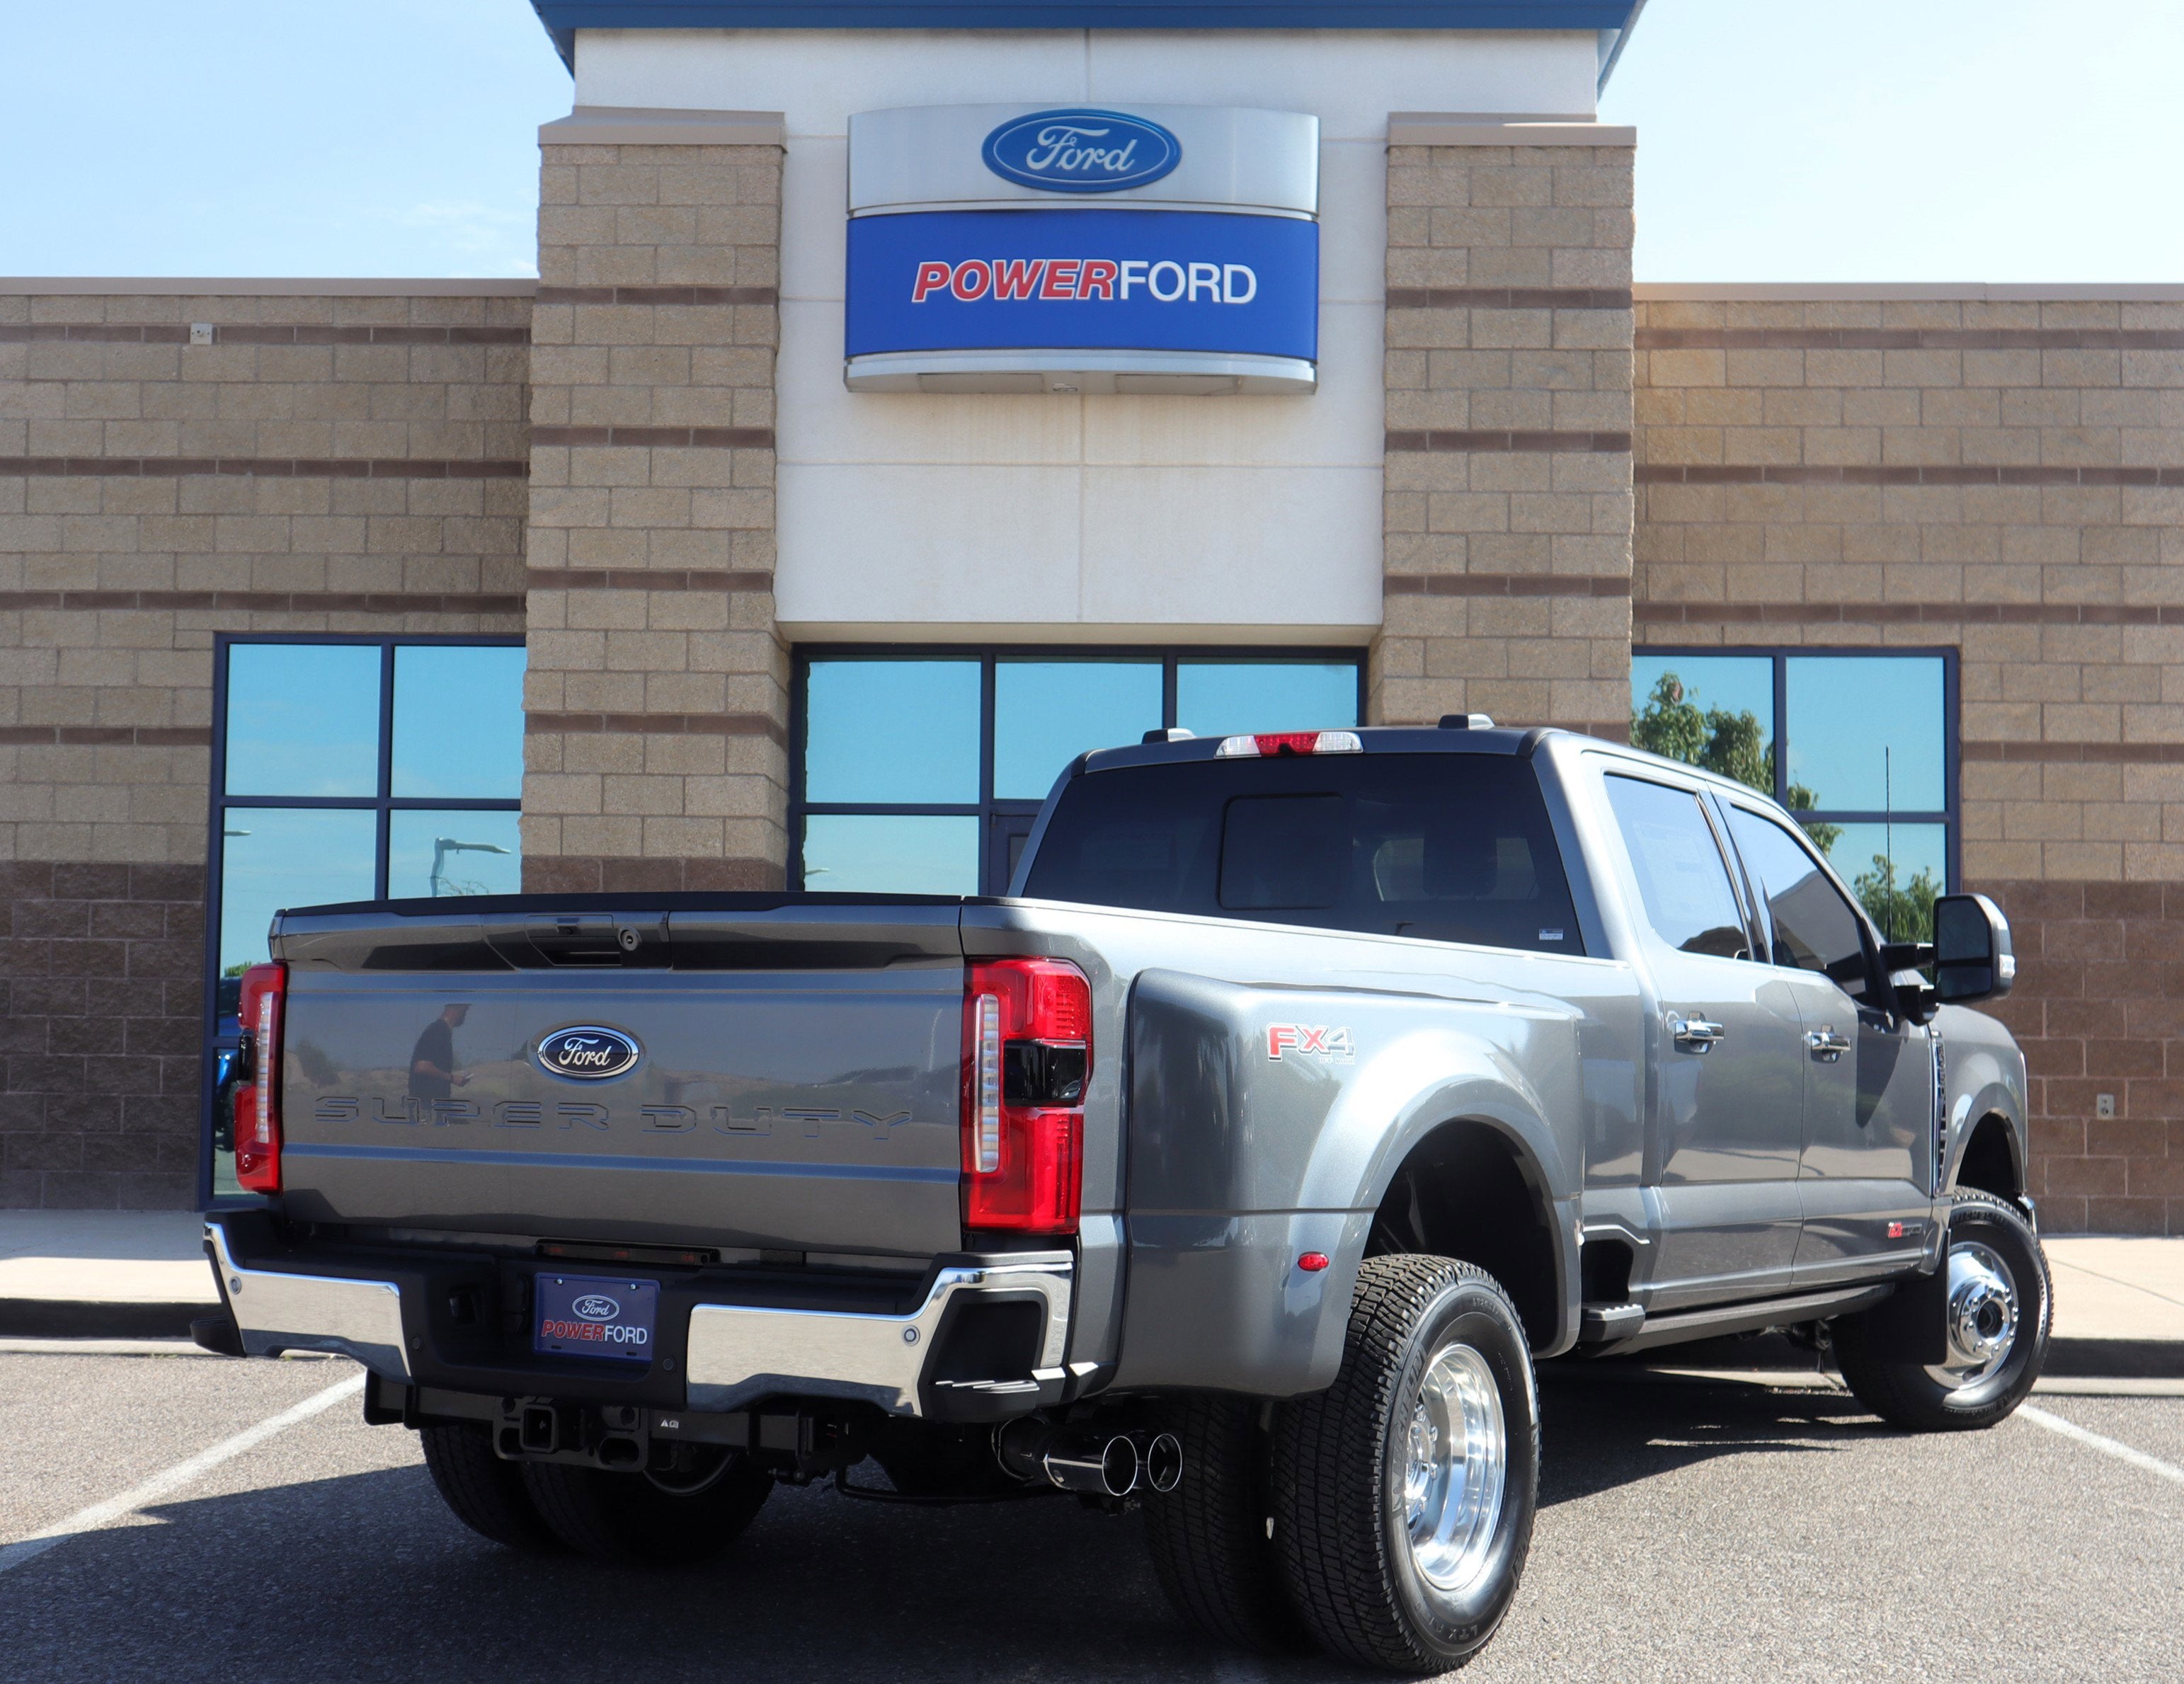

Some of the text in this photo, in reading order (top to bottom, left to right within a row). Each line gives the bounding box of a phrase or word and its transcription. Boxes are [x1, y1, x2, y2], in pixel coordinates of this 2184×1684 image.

[1026, 125, 1138, 171] Ford
[559, 1037, 612, 1066] Ford
[1266, 1022, 1356, 1062] FX4
[315, 1096, 912, 1140] SUPER DUTY
[581, 1299, 611, 1317] Ford
